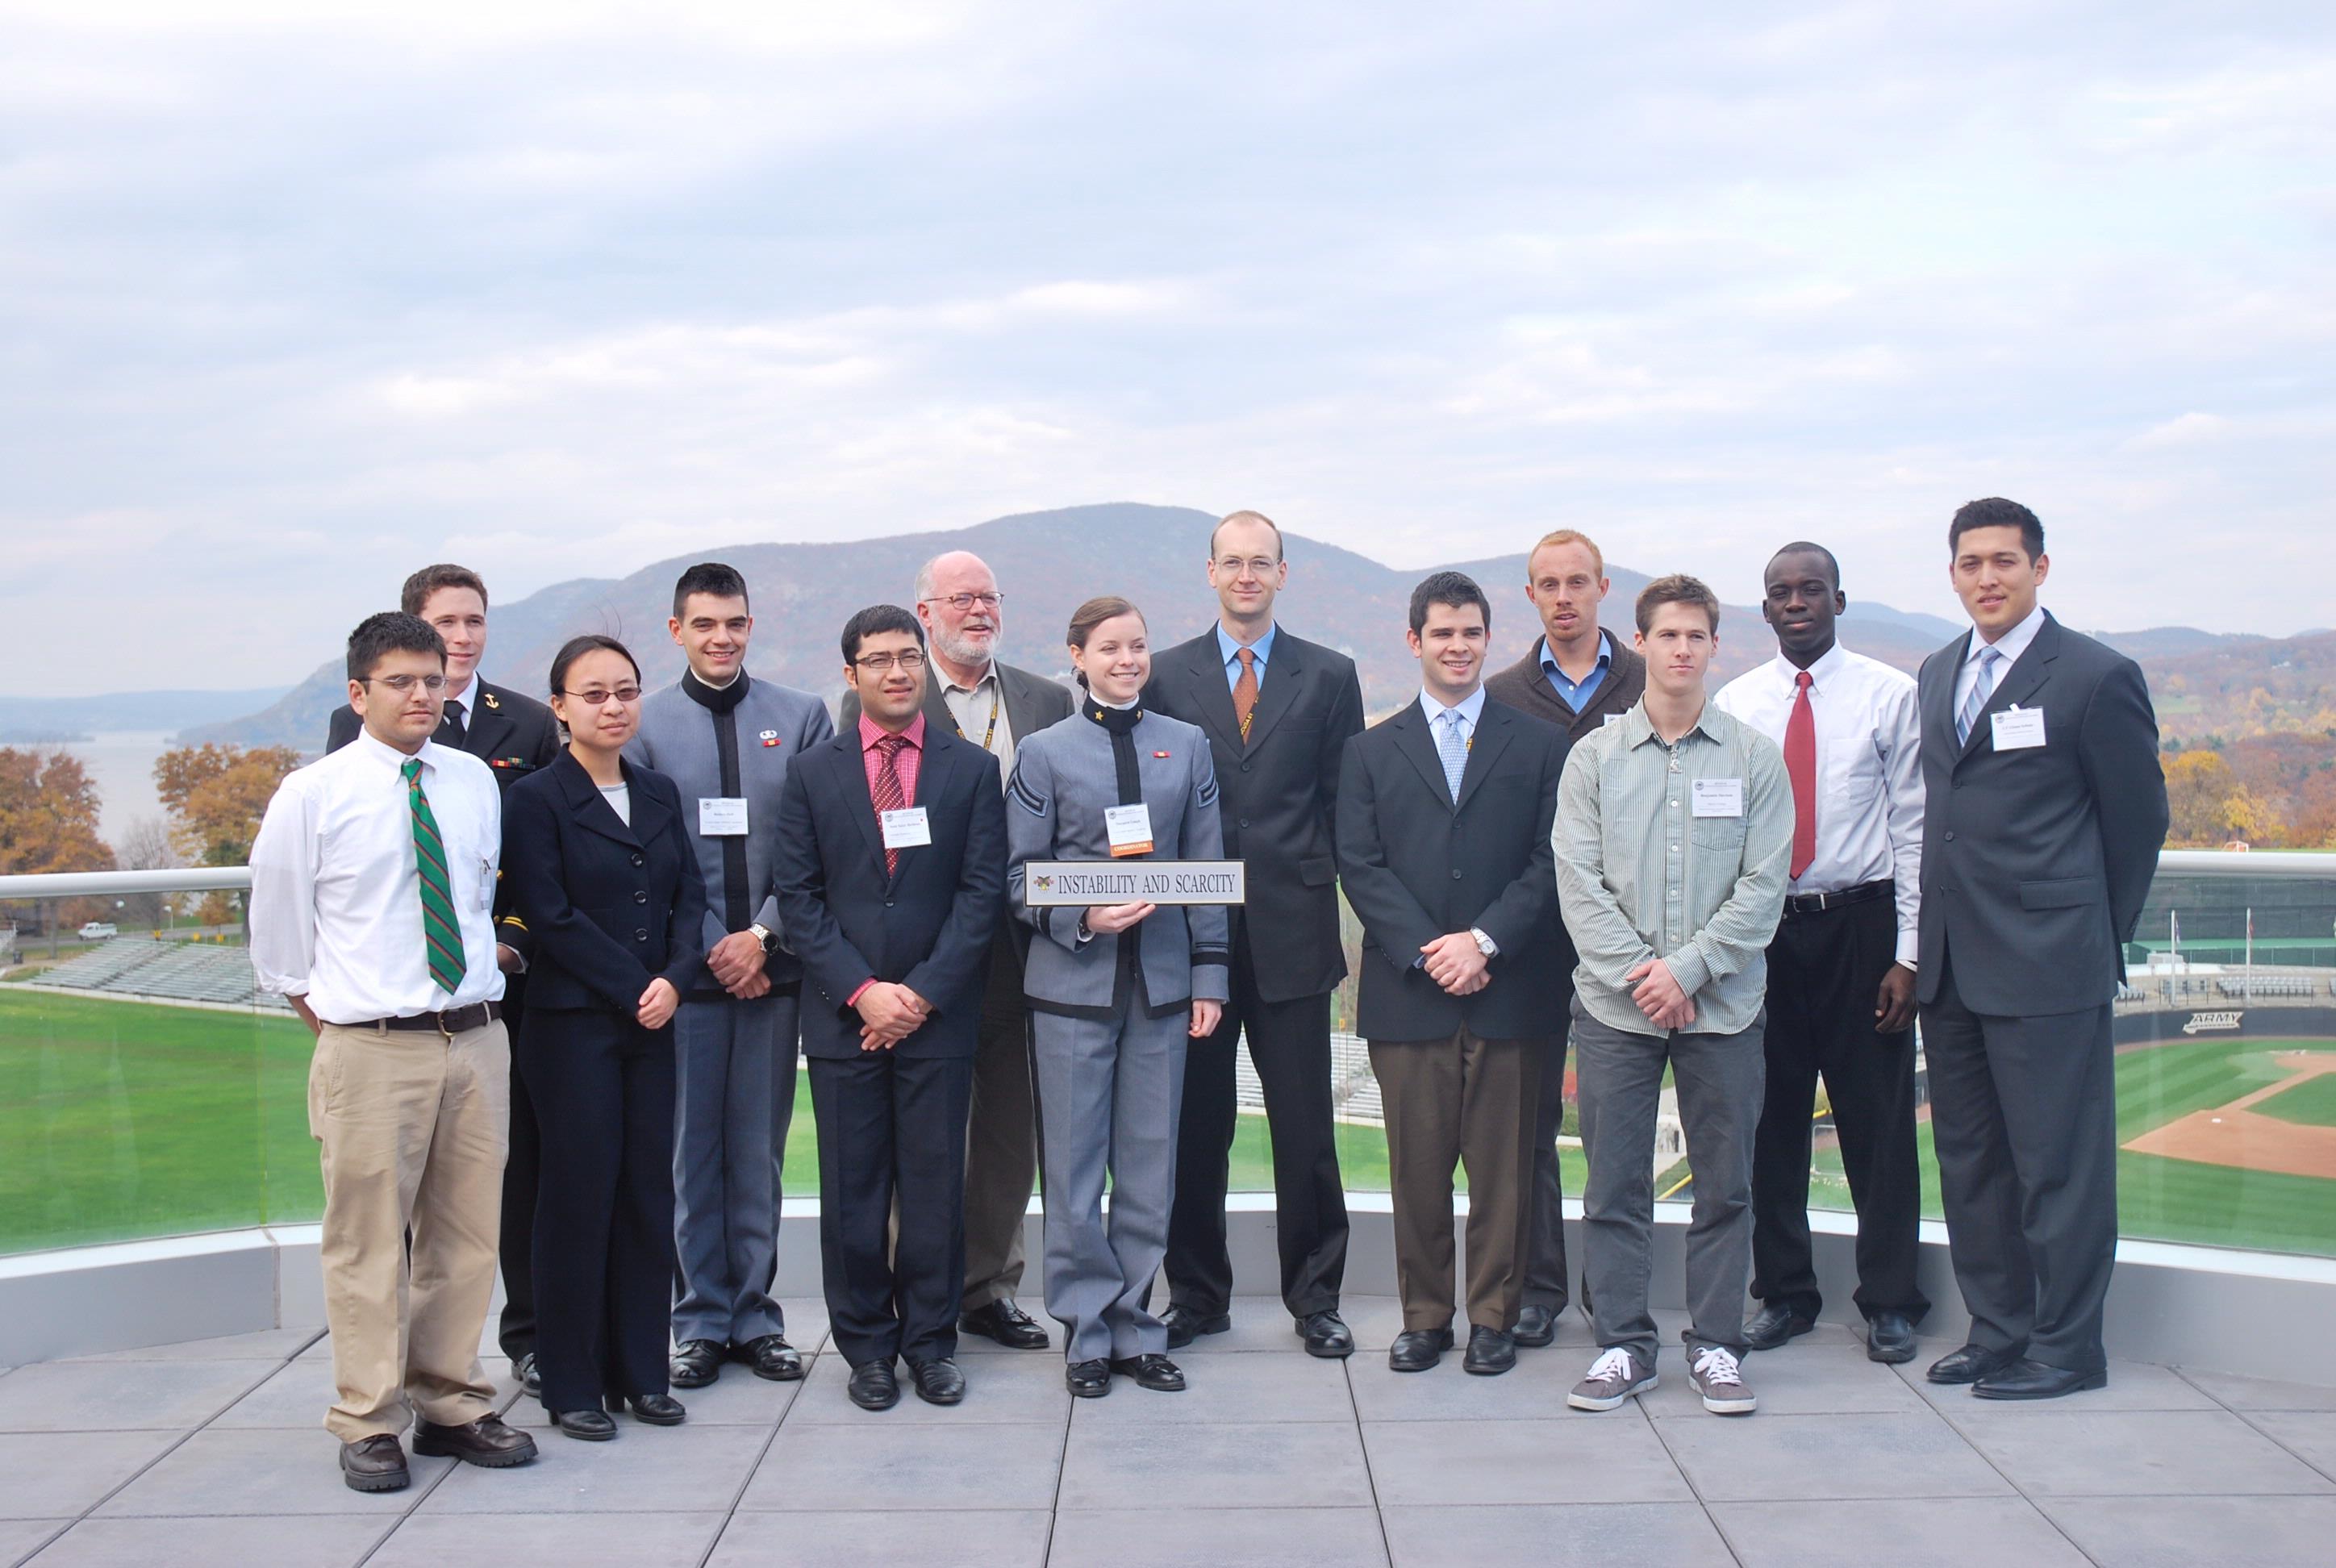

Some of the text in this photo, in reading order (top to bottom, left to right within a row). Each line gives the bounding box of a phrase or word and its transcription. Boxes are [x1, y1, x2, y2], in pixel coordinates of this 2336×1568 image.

[1058, 874, 1236, 895] INSTABILITY AND SCARCITY
[2193, 1013, 2238, 1023] ARMY
